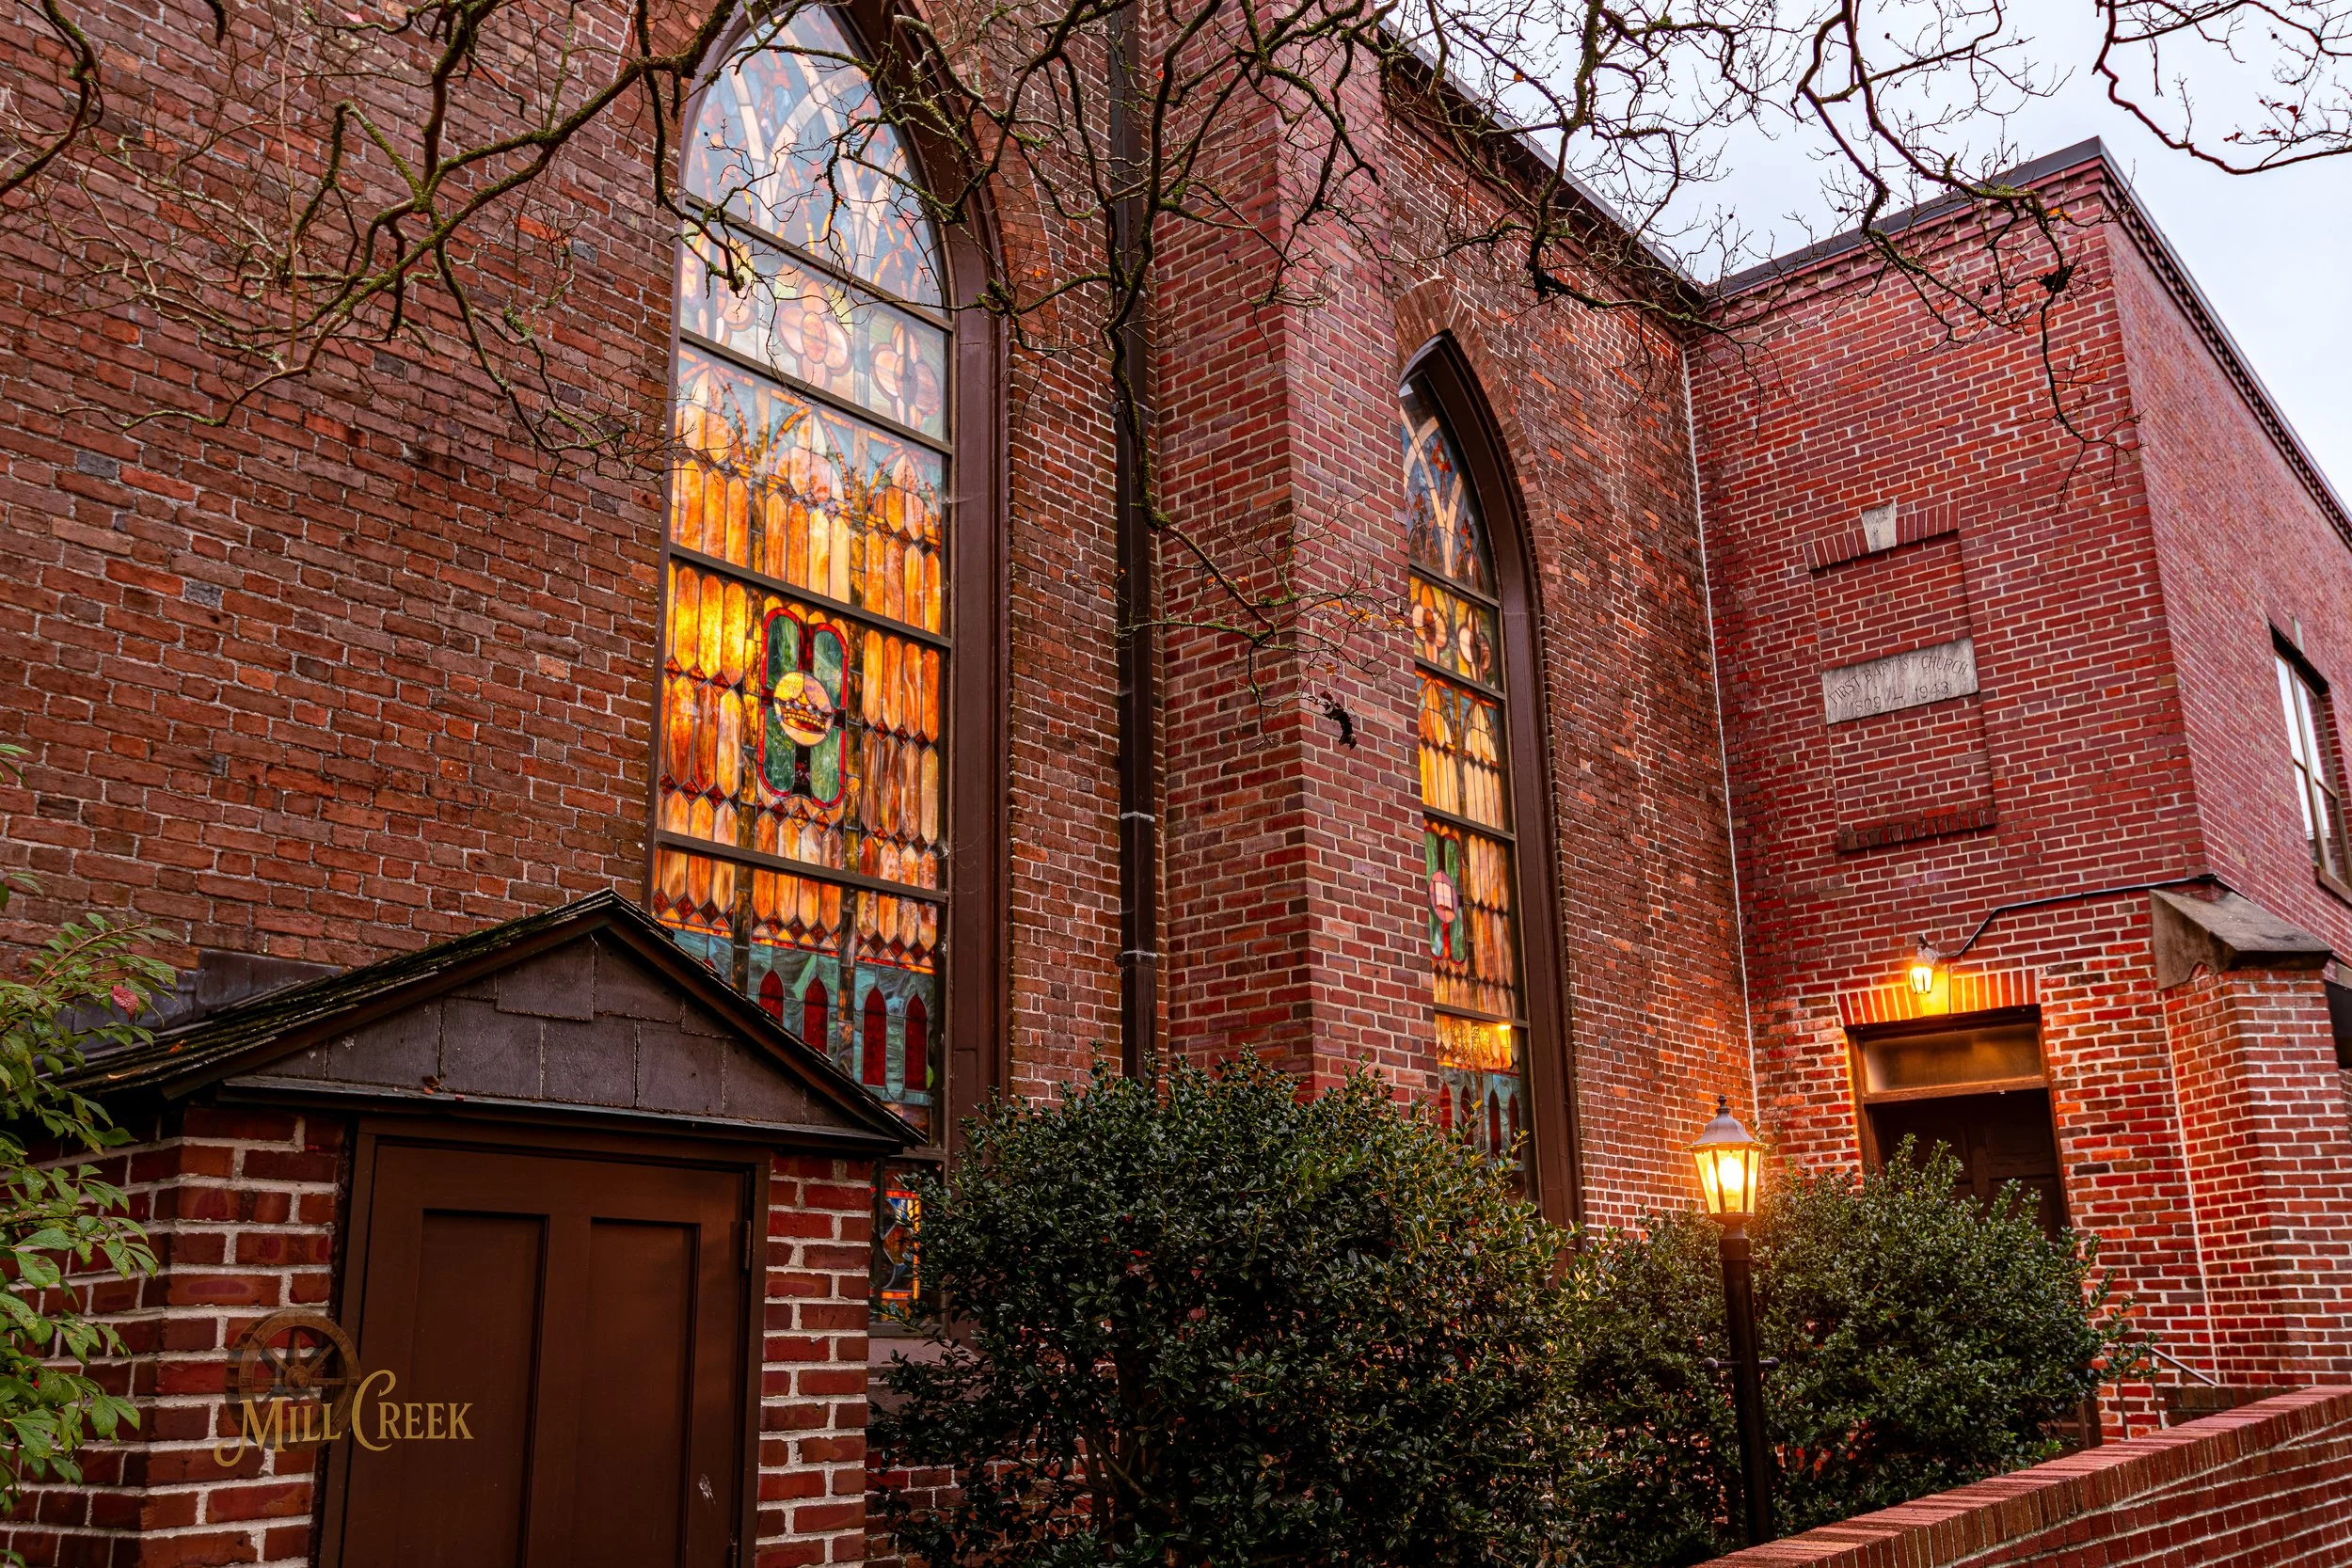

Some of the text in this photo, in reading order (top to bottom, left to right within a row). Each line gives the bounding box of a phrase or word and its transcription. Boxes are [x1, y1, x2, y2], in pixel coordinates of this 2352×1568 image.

[1829, 656, 1969, 705] FIRST BAPTIST CHURCH
[1851, 695, 1882, 712] 1809
[1915, 681, 1949, 701] 1943
